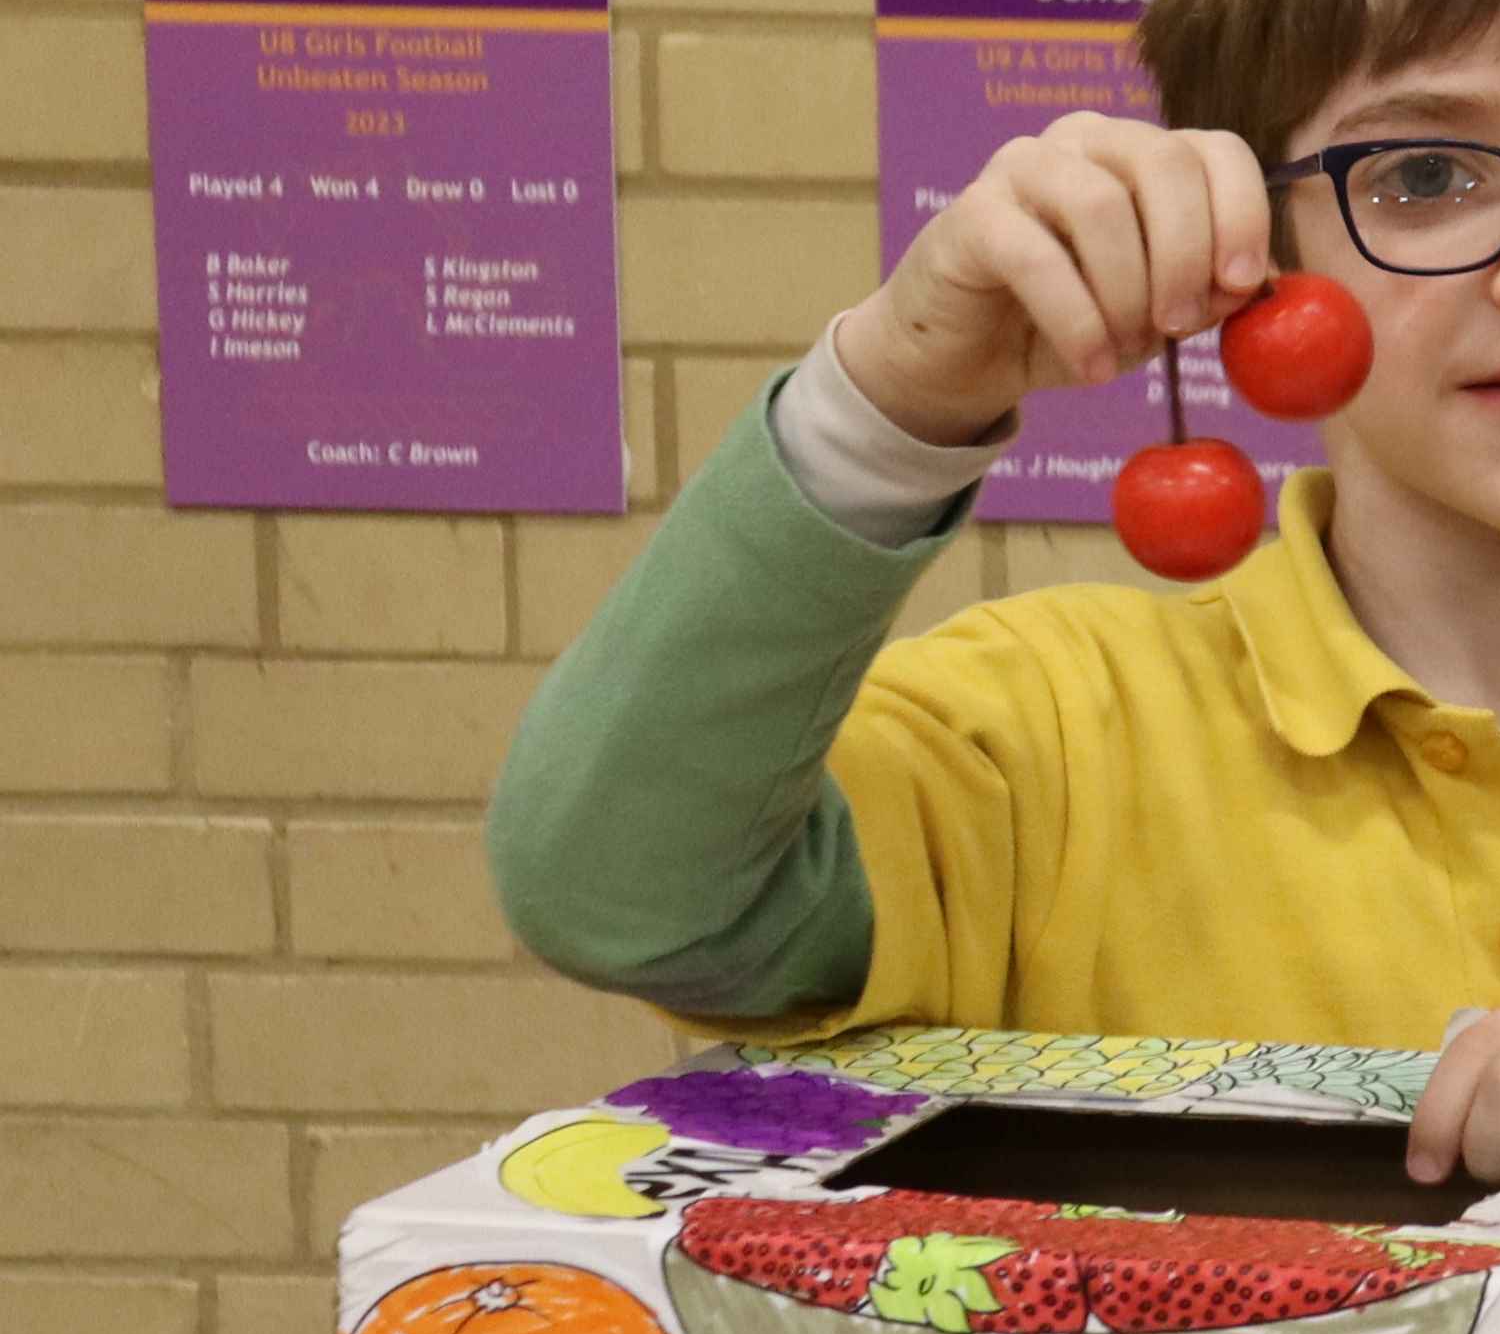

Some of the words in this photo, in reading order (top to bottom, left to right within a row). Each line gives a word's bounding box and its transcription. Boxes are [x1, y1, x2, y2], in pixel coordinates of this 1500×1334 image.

[305, 30, 365, 58] Girls
[376, 31, 485, 59] Football
[1045, 44, 1106, 72] Girls
[257, 64, 388, 92] Unbeaten
[396, 67, 489, 93] Season
[985, 81, 1113, 109] Unbeaten
[189, 173, 261, 201] Played
[268, 174, 283, 197] 4
[310, 175, 358, 199] Won
[365, 177, 380, 200] 4
[406, 177, 463, 201] Drew
[511, 179, 557, 202] Lost
[443, 257, 538, 283] Kingston
[444, 285, 510, 312] Regan
[232, 308, 306, 336] Hickey
[445, 312, 575, 338] McClements
[224, 336, 300, 359] Imeson
[307, 440, 380, 465] Coach:
[410, 441, 479, 466] Brown
